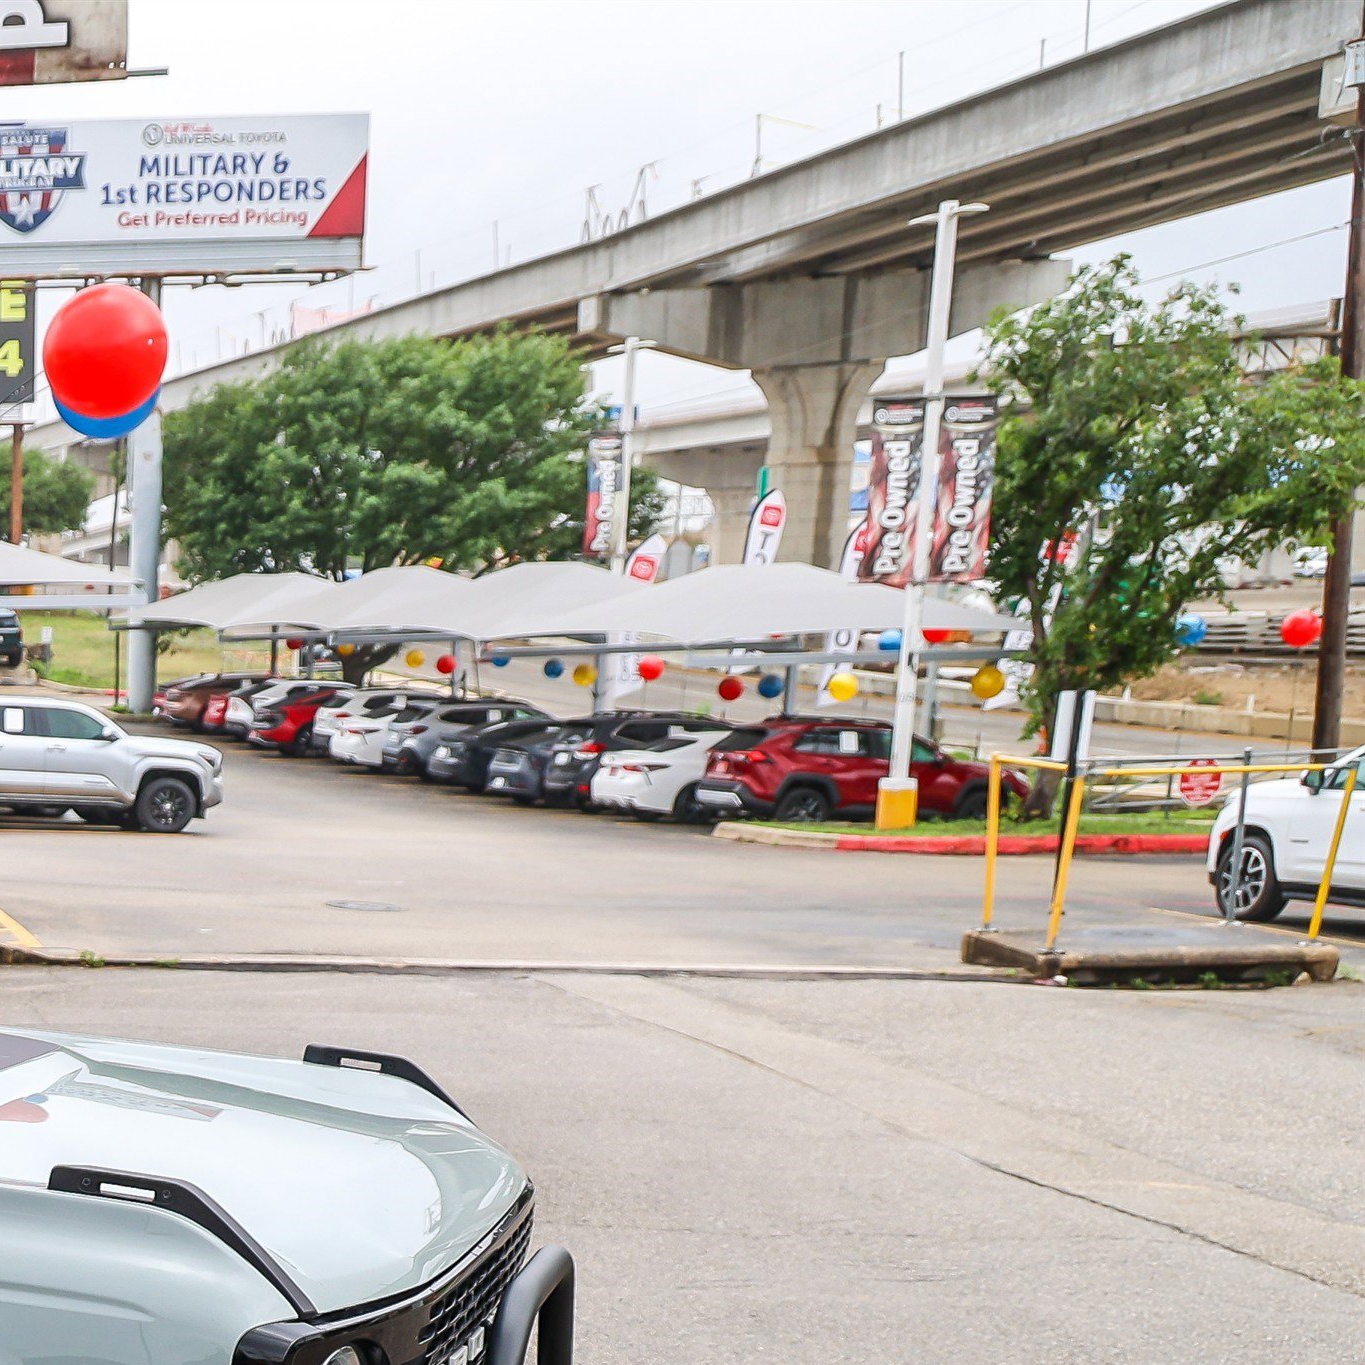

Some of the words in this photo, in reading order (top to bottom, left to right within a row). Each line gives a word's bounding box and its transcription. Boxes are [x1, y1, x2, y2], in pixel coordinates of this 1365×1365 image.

[165, 133, 235, 146] UNIVERSAL
[238, 131, 287, 144] TOYOTA
[139, 152, 265, 177] MILITARY
[273, 152, 290, 174] &
[101, 182, 138, 206] 1st
[146, 176, 327, 204] RESPONDERS
[118, 211, 149, 227] Get
[155, 207, 240, 226] Preferred
[245, 206, 309, 227] Pricing
[882, 441, 912, 529] Owned
[947, 439, 979, 527] Owned
